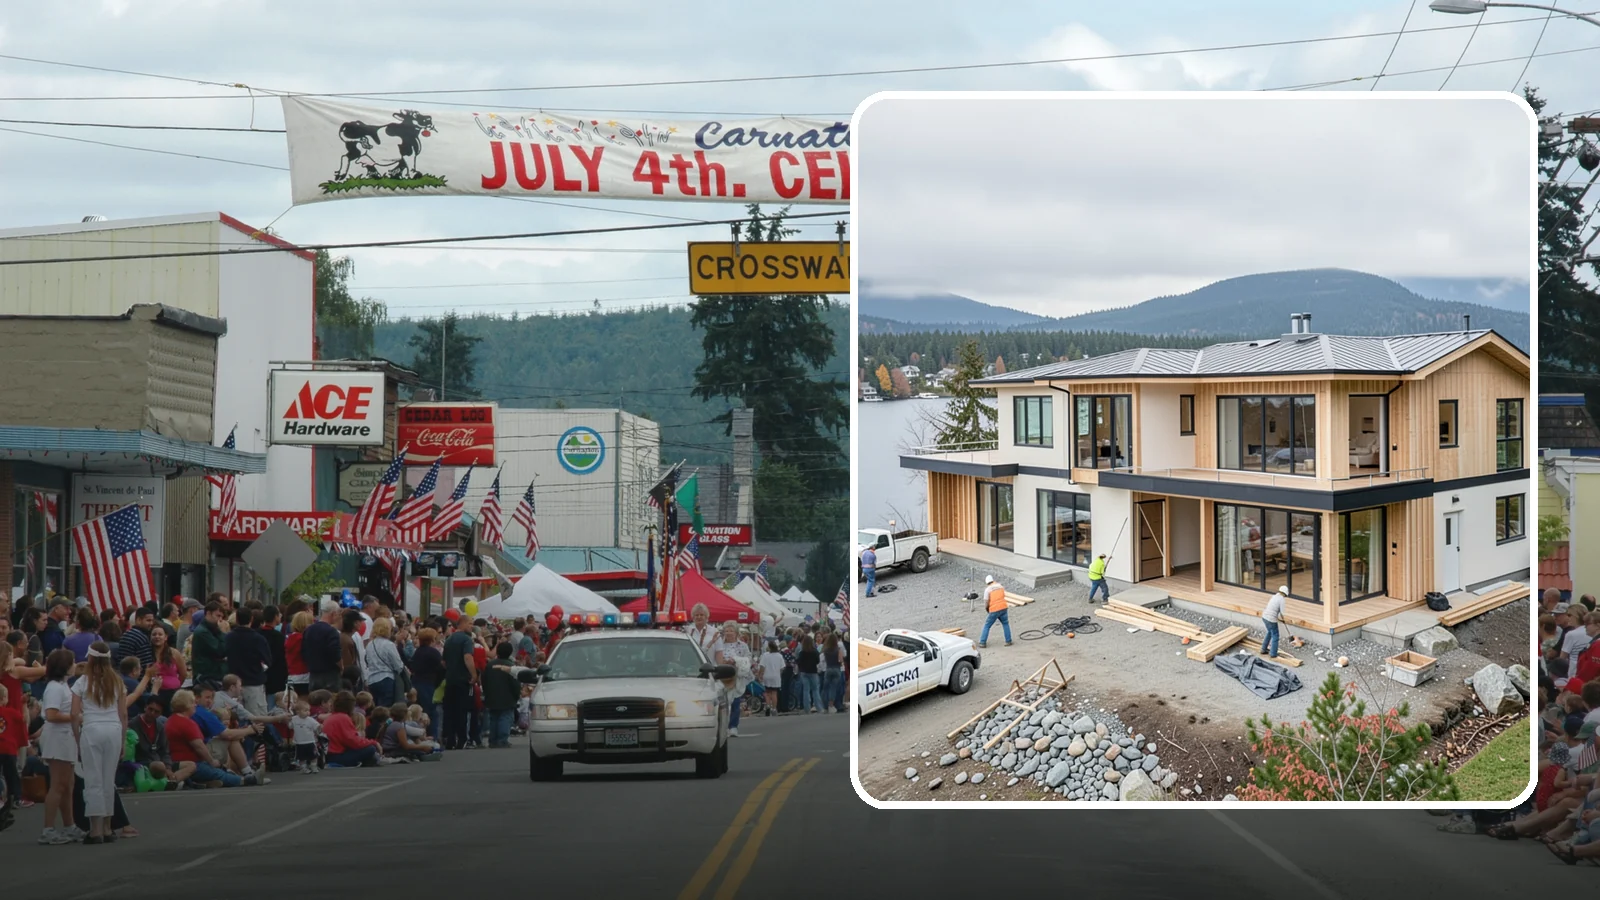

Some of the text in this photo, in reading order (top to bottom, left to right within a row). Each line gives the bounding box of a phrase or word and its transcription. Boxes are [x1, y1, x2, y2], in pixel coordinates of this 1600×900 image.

[481, 140, 605, 193] JULY
[632, 150, 746, 198] 4th.
[697, 254, 850, 280] CROSSWA
[282, 380, 373, 420] ACE
[405, 409, 452, 422] CEDAR
[283, 421, 370, 436] Hardware
[83, 484, 155, 495] St. Vincent de Paul
[81, 503, 153, 522] THT
[213, 516, 331, 535] HARDARE
[699, 535, 730, 543] GLASS
